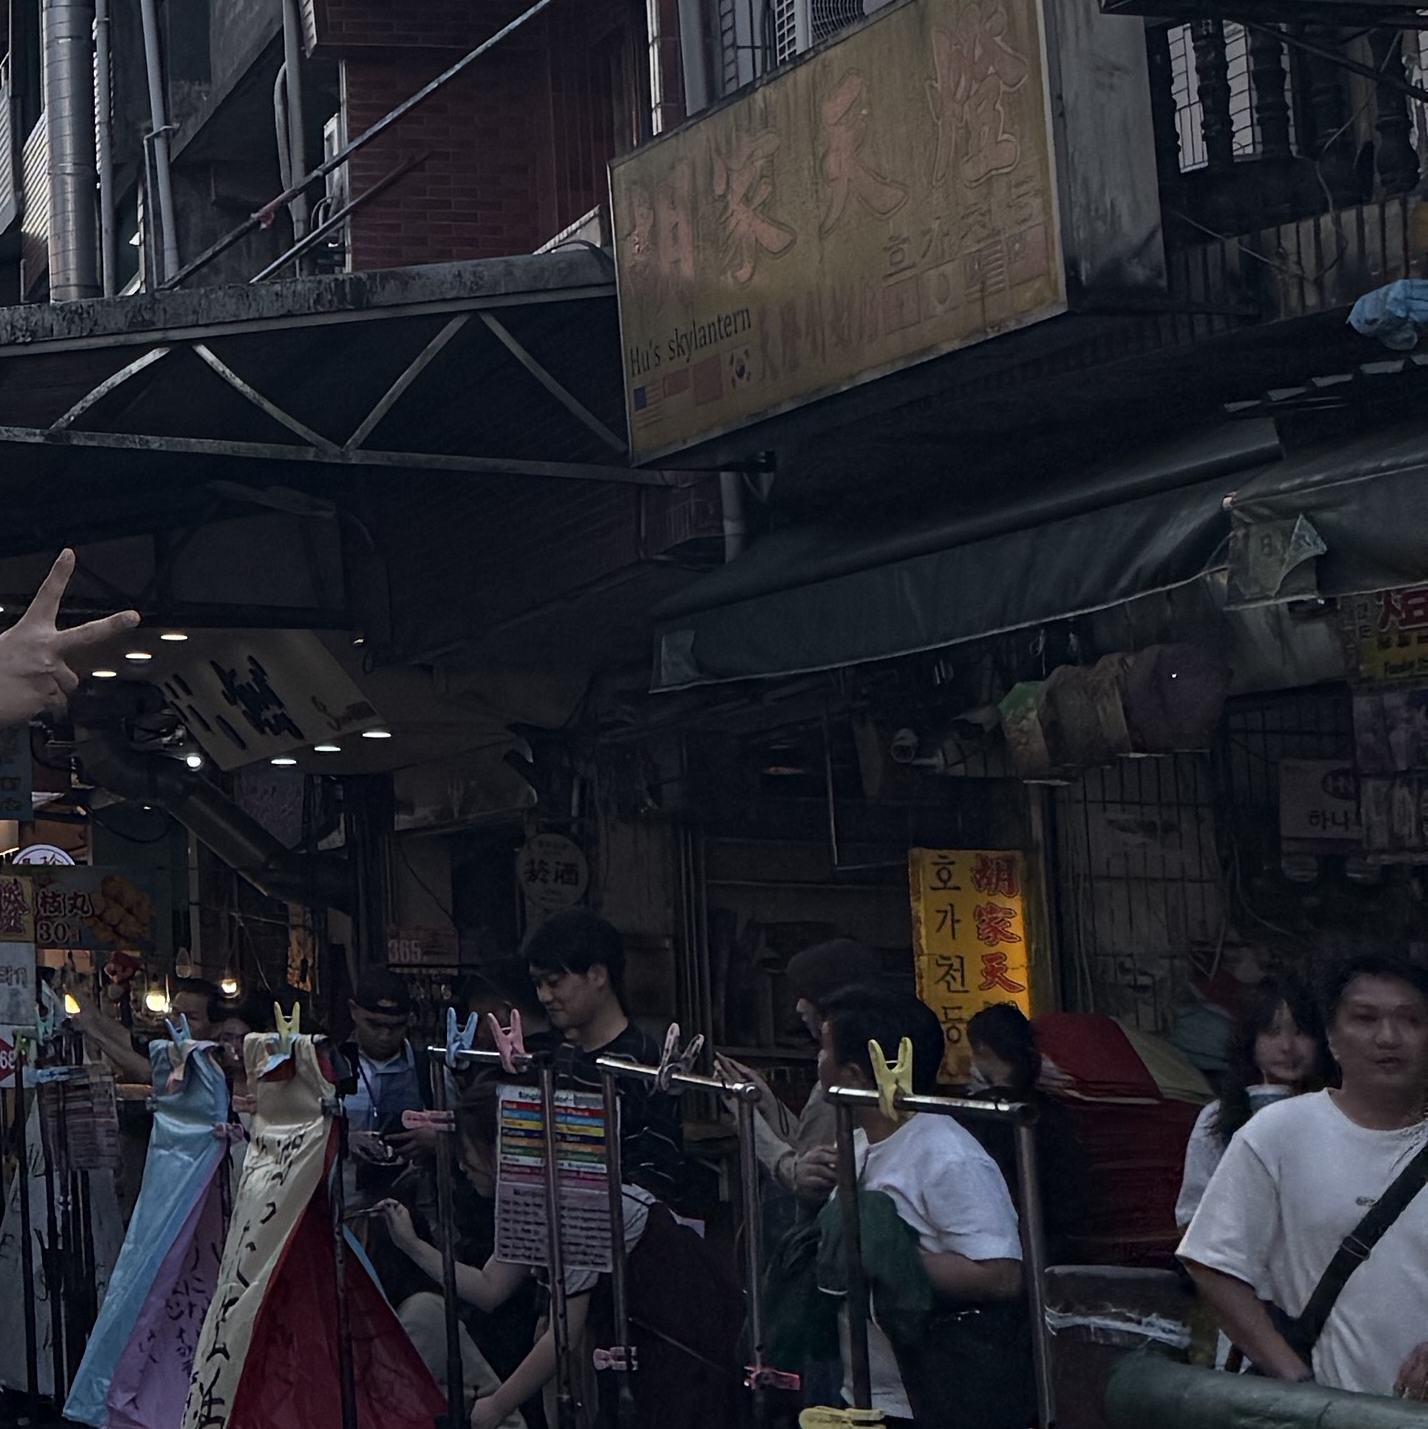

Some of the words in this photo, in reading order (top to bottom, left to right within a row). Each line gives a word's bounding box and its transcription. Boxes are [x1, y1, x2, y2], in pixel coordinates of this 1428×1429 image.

[629, 342, 662, 378] Hu's
[668, 307, 752, 364] skylantern
[929, 855, 970, 1045] 호가천등
[971, 853, 1027, 1009] 胡家天
